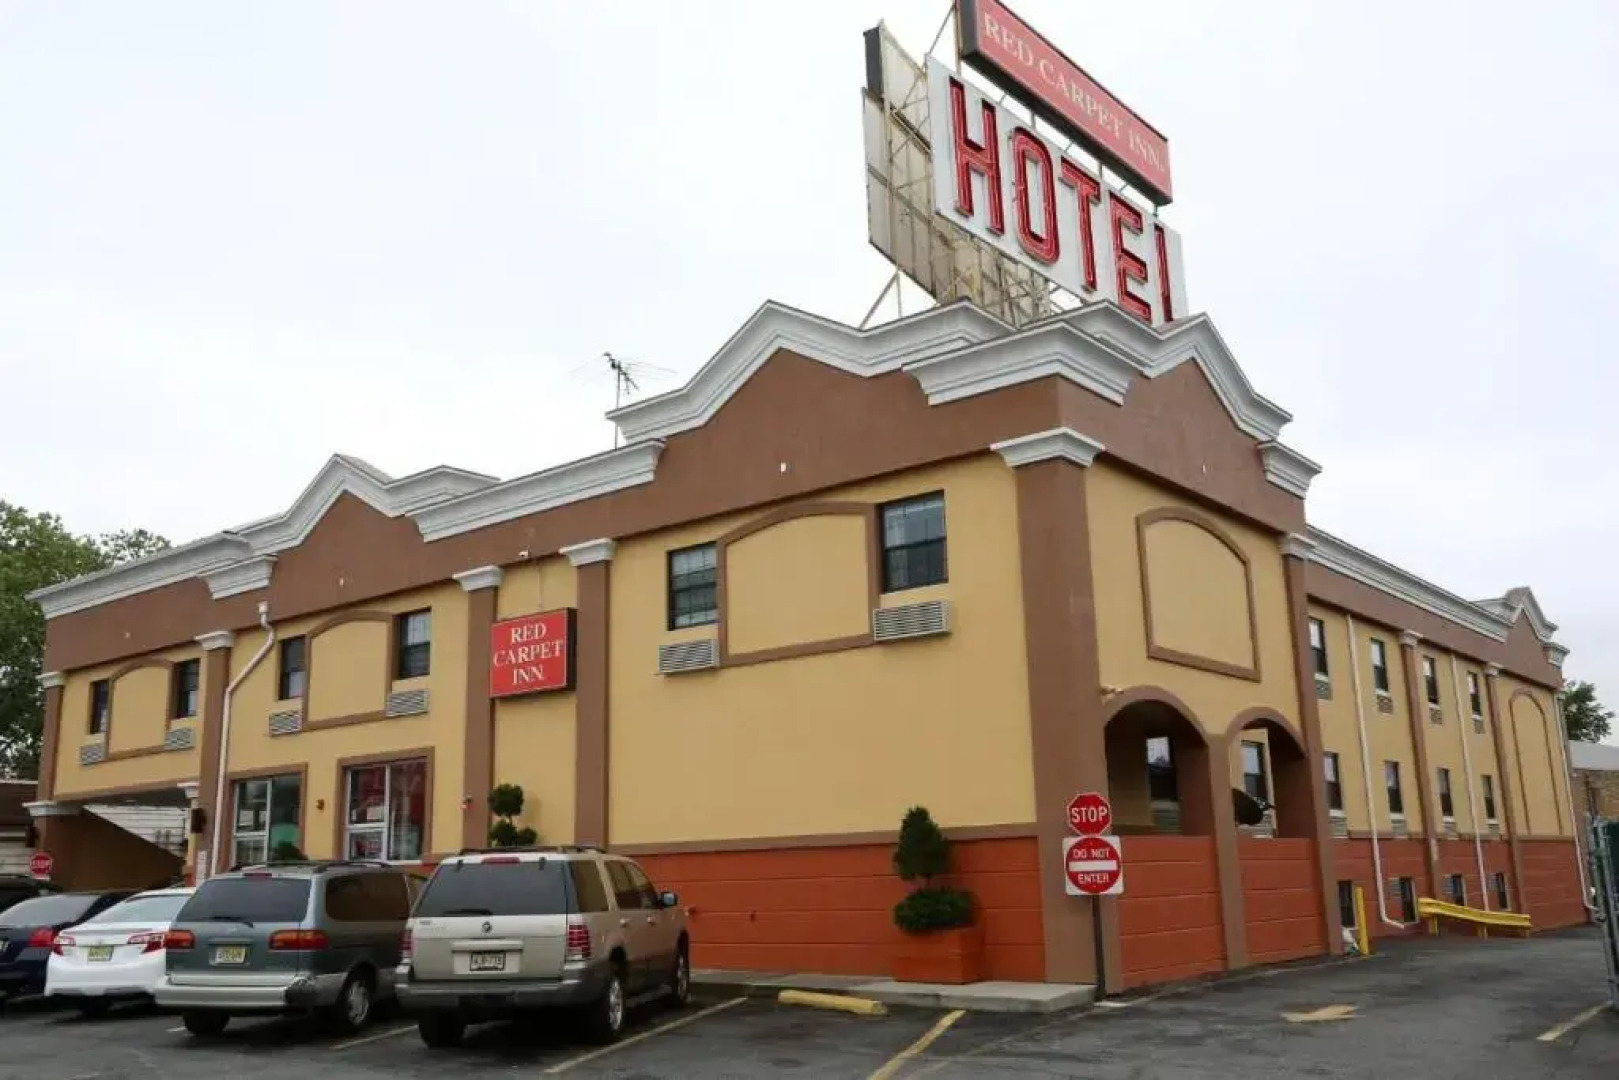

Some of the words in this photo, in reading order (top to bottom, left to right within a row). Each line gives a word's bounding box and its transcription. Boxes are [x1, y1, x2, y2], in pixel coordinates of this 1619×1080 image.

[984, 12, 1034, 67] RED
[1039, 58, 1124, 138] CARPET
[511, 622, 547, 644] RED
[493, 639, 564, 667] CARPET
[512, 664, 545, 685] INN
[1071, 805, 1108, 823] STOP
[1073, 848, 1088, 859] DO
[1091, 848, 1110, 859] NOT
[1077, 873, 1110, 884] ENTER
